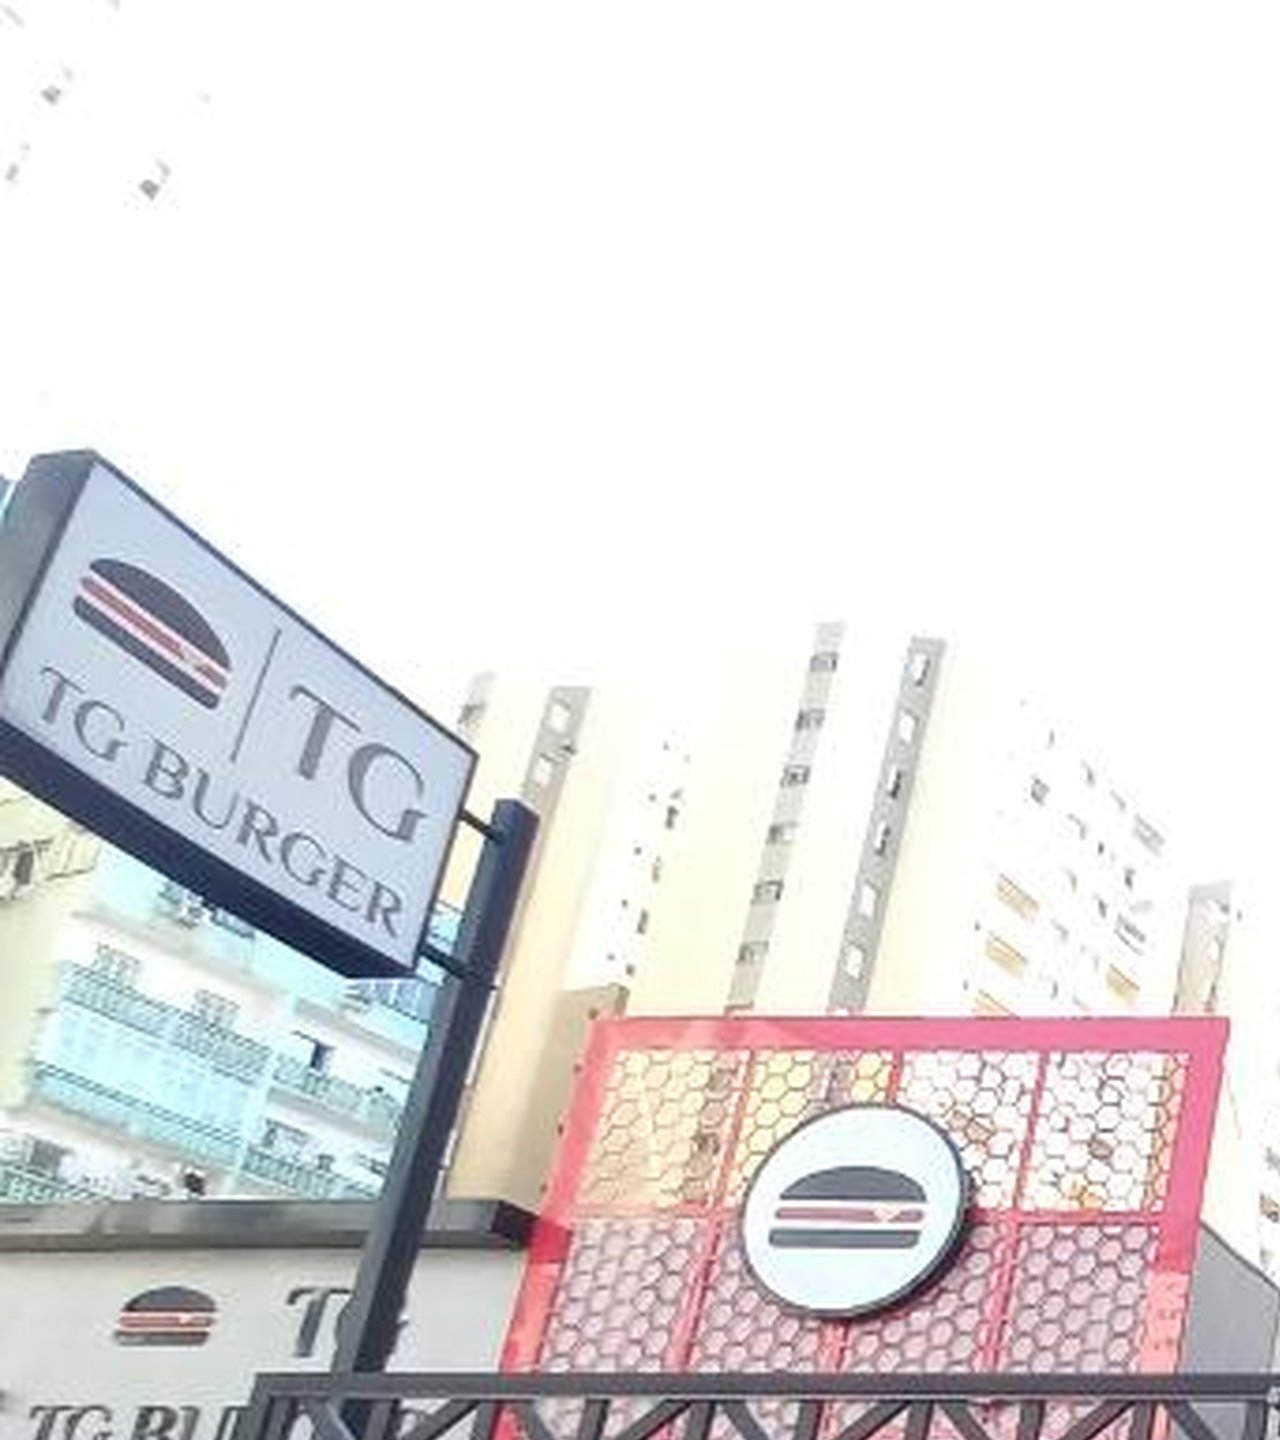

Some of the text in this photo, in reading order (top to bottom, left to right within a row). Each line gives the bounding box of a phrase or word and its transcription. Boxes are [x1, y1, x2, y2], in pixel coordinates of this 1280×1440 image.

[39, 666, 402, 938] TG BURGER
[291, 684, 428, 844] TG
